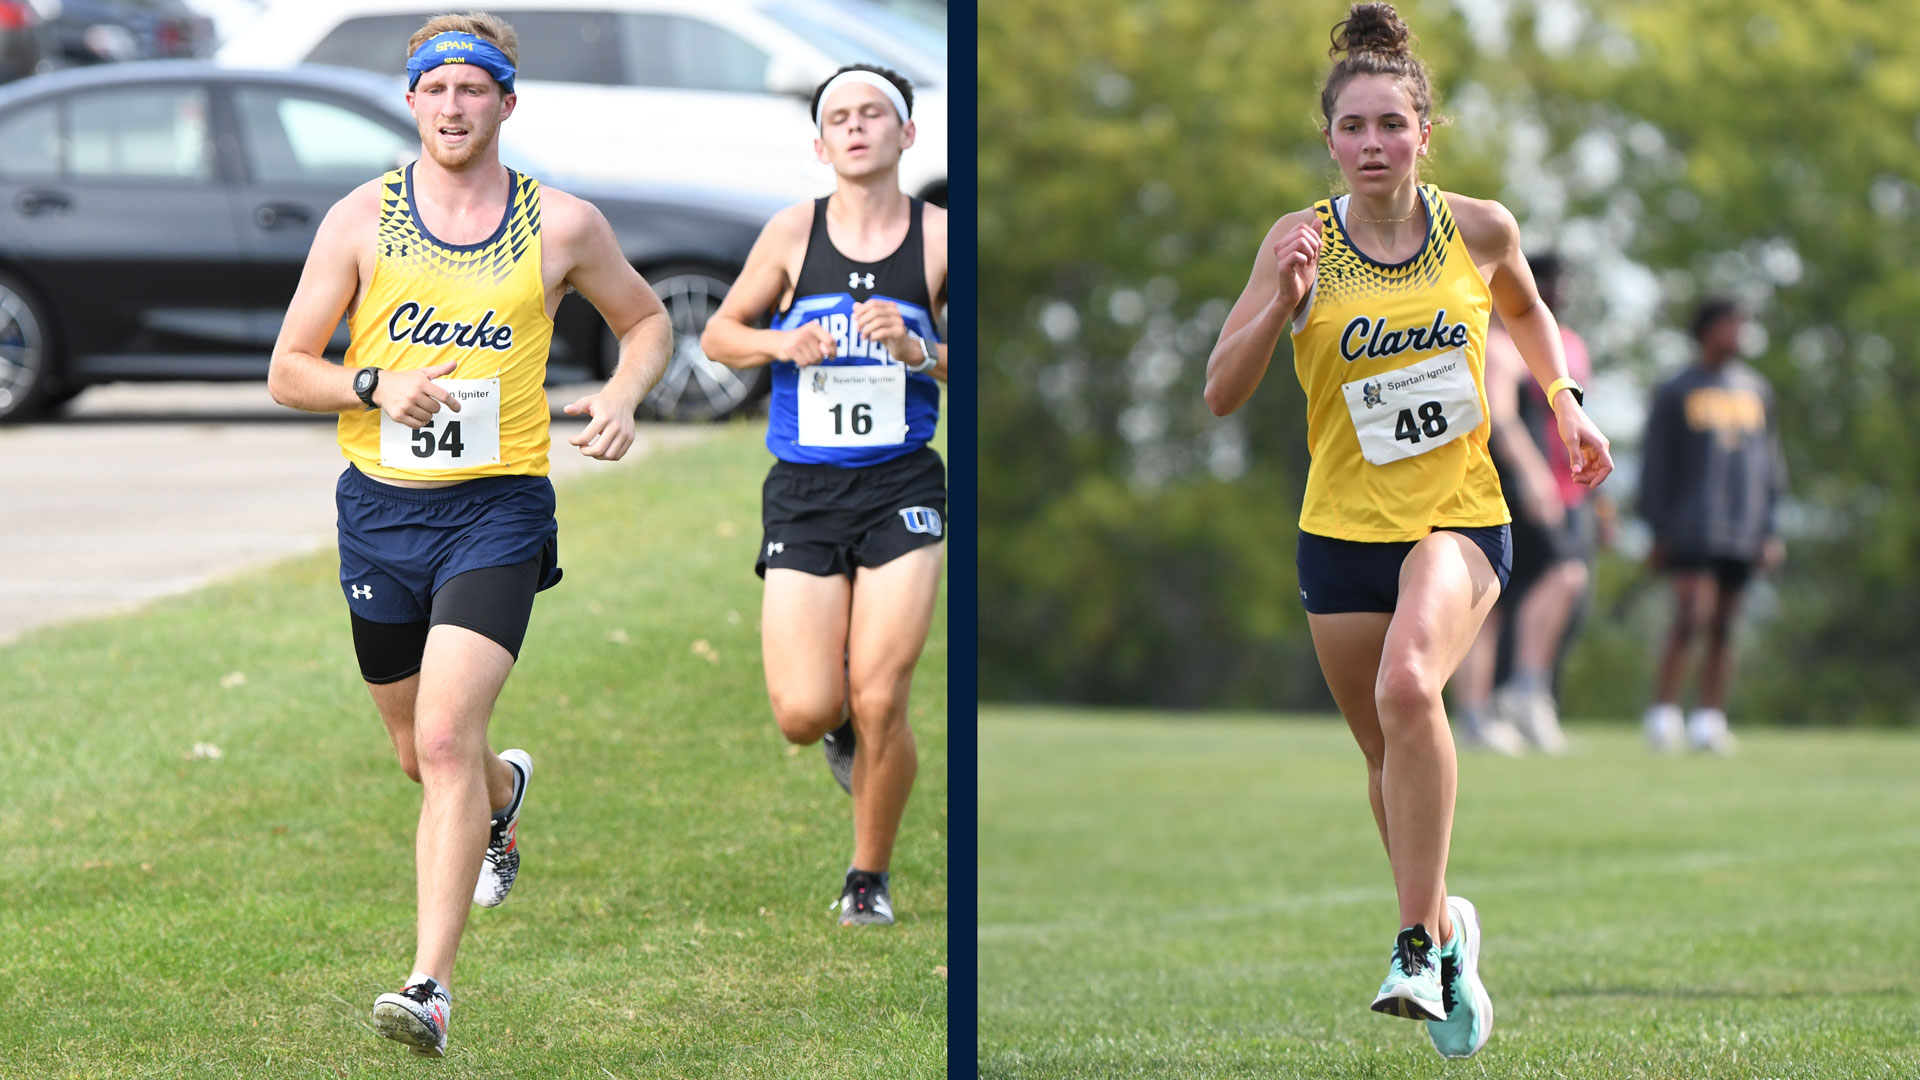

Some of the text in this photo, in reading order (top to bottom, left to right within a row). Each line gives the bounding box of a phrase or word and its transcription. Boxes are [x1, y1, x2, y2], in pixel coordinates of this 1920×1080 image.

[435, 41, 474, 52] SPAM
[388, 301, 513, 350] Clarke
[1340, 309, 1468, 362] Clarke
[1387, 362, 1456, 390] Spartan Igniter
[458, 390, 489, 400] Igniter
[829, 404, 873, 435] 16
[1395, 401, 1448, 444] 48
[411, 420, 464, 458] 54
